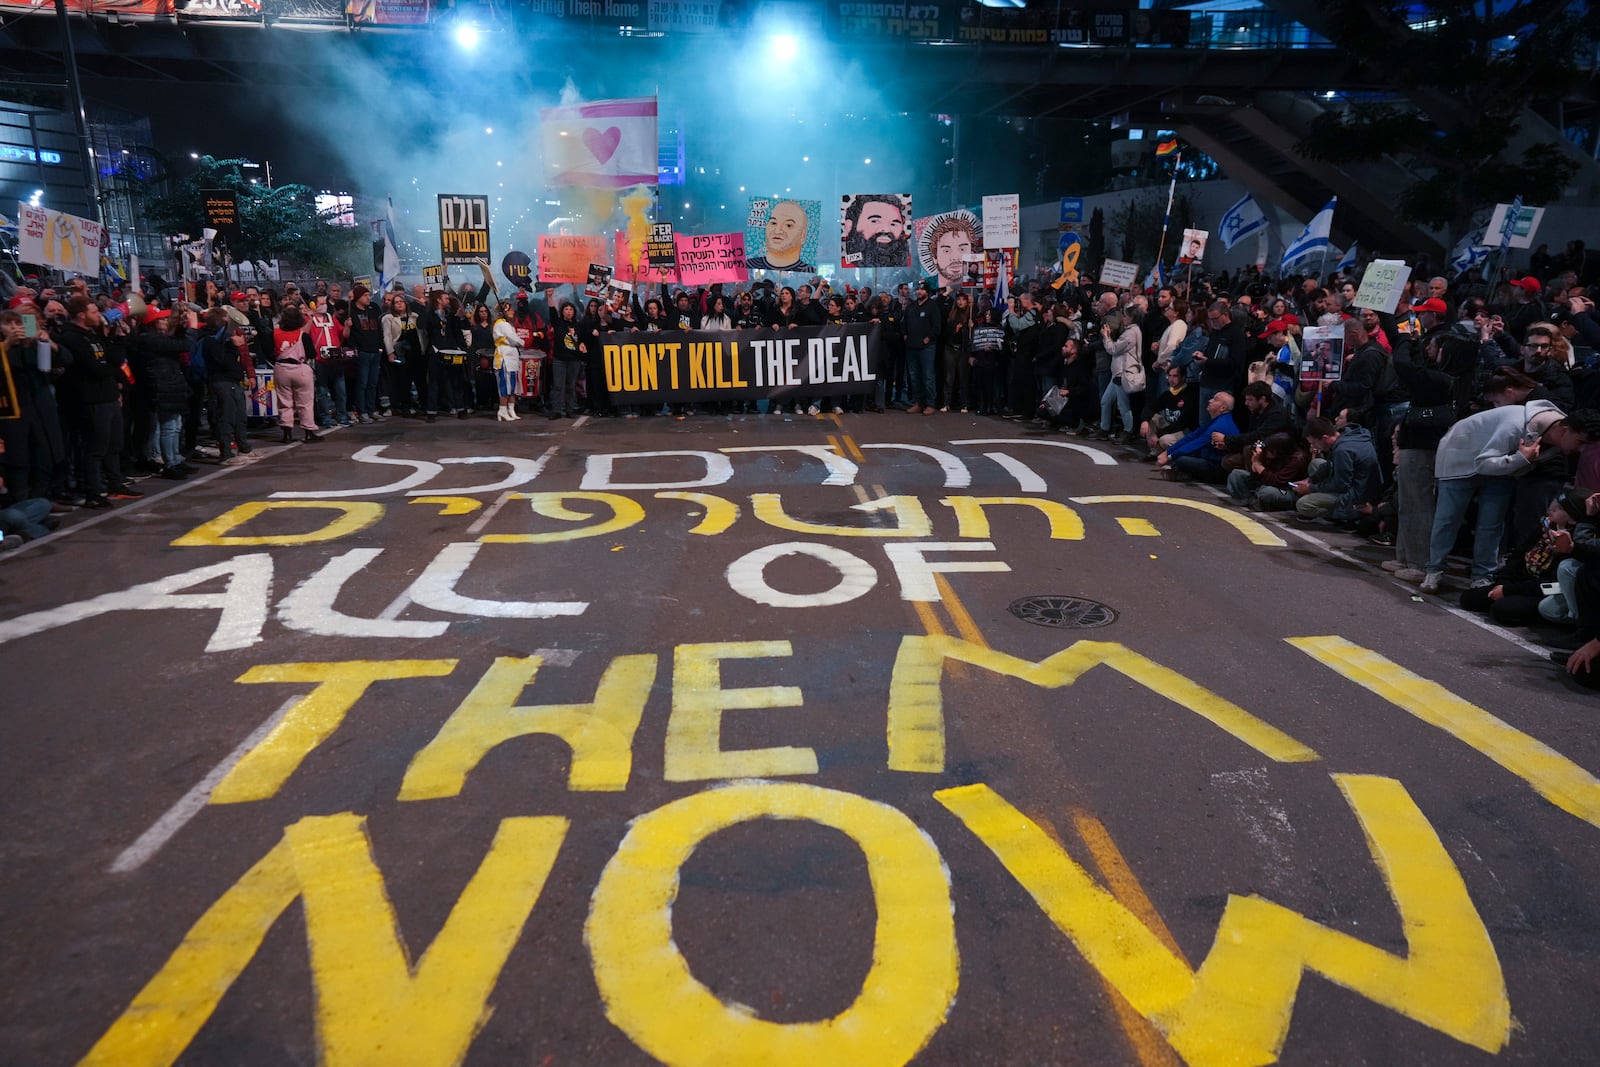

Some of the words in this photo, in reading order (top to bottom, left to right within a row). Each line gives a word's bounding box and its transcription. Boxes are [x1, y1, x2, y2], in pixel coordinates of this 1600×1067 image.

[604, 0, 640, 17] Home
[839, 3, 906, 17] החטופים
[440, 196, 487, 229] כולם
[443, 230, 488, 253] עכשיו!
[693, 234, 731, 249] עדיפים
[717, 247, 744, 258] כאבי
[680, 249, 715, 263] העסקה
[603, 343, 681, 392] DON'T
[688, 342, 748, 389] KILL
[750, 339, 801, 387] THE
[808, 335, 876, 384] DEAL
[170, 486, 1288, 547] החטופים
[0, 543, 589, 651] ALL
[726, 541, 1011, 608] OF
[75, 773, 1512, 1067] NOW
